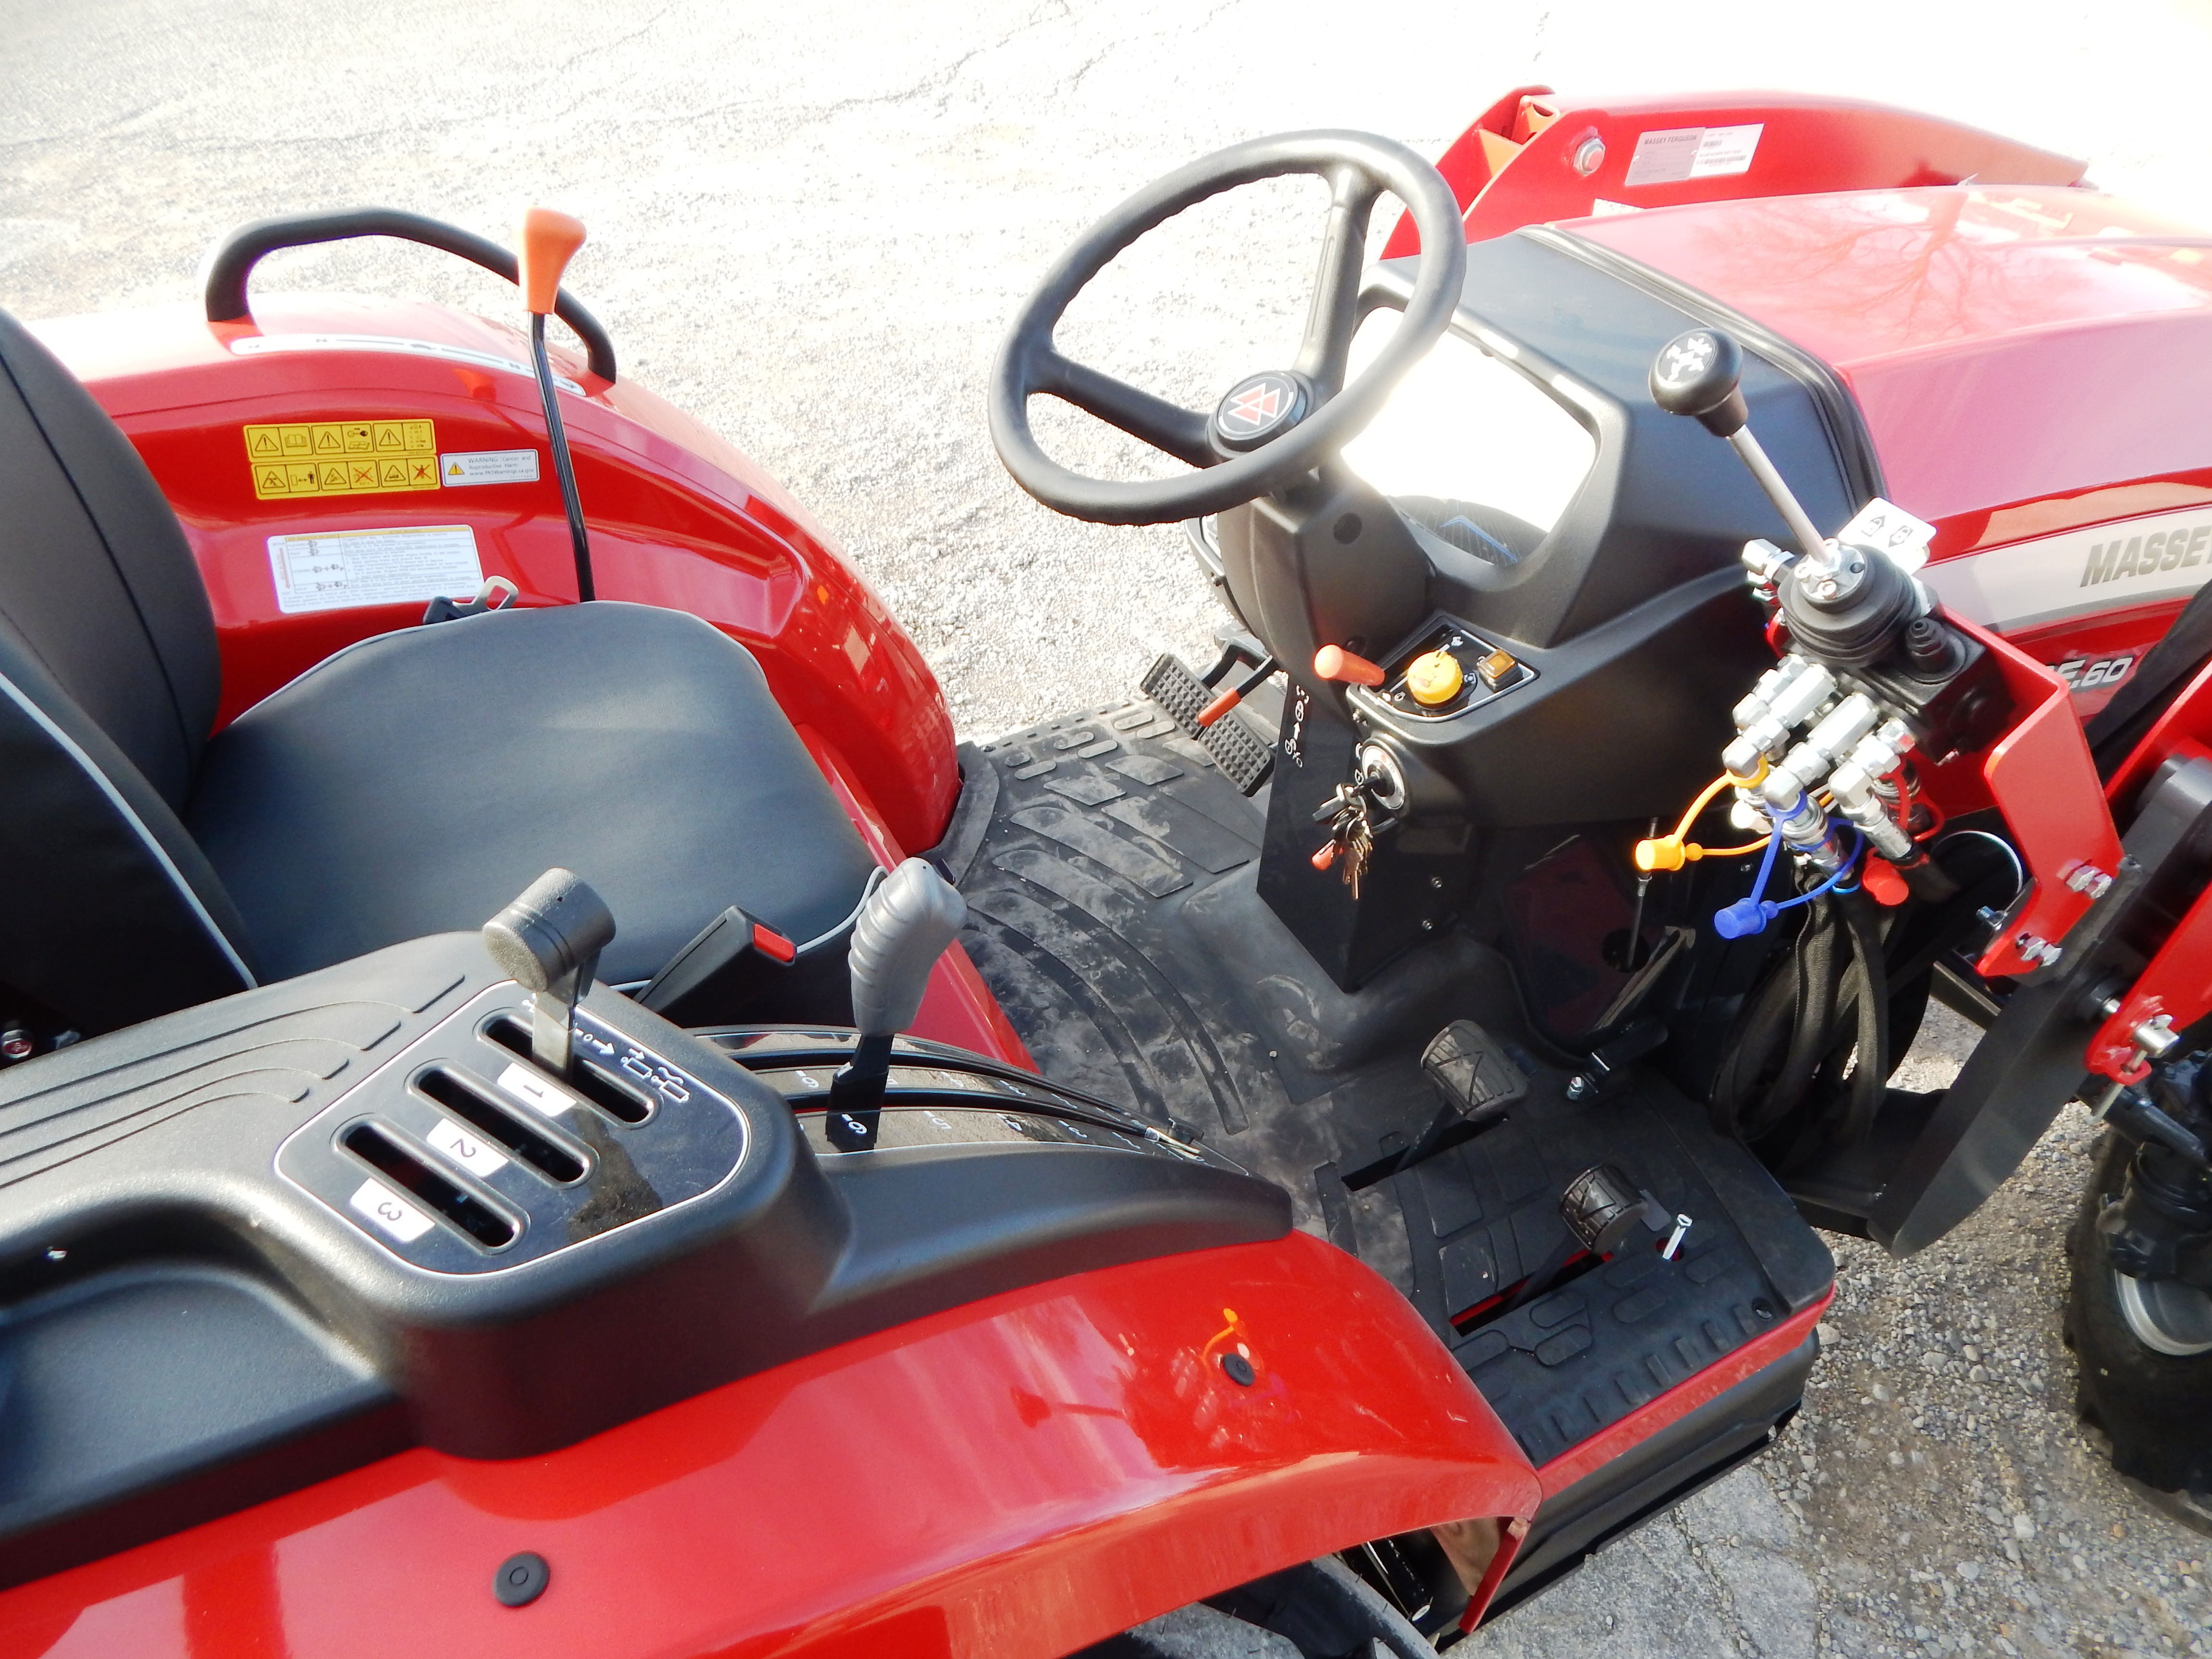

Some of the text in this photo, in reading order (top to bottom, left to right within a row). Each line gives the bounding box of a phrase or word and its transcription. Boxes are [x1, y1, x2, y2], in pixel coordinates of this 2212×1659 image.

[1667, 134, 1698, 143] FERGUSON
[2080, 525, 2212, 588] MASSE
[523, 1084, 544, 1099] 1
[931, 1118, 952, 1130] 5
[1005, 1119, 1022, 1131] 4
[450, 1138, 477, 1158] 2
[377, 1201, 403, 1221] 3
